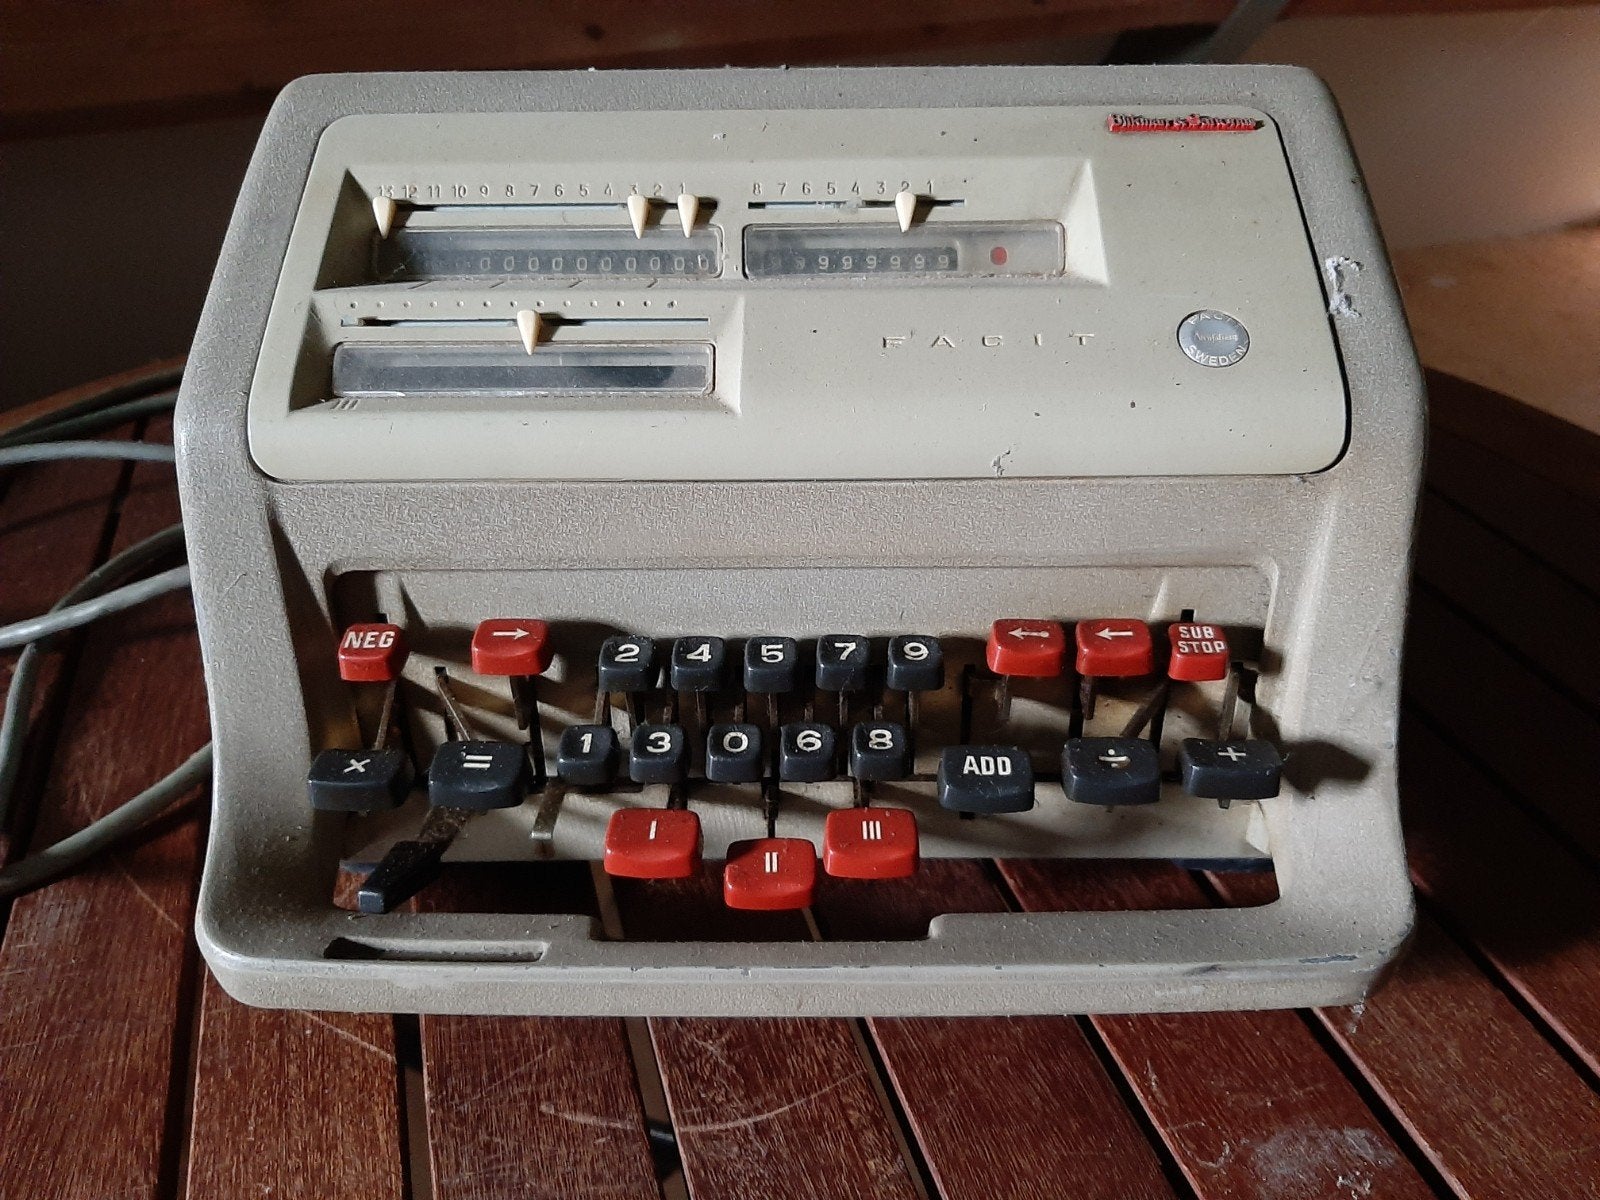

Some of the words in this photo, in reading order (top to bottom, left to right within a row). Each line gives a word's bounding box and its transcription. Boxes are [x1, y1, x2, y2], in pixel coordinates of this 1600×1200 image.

[402, 185, 418, 199] 12
[428, 185, 442, 198] 11
[452, 185, 468, 198] 10
[479, 185, 490, 198] 9
[505, 184, 516, 198] 8
[529, 184, 541, 197] 7
[554, 184, 564, 197] 6
[579, 184, 590, 197] 5
[604, 183, 614, 196] 4
[653, 183, 663, 196] 2
[752, 181, 762, 195] 8
[777, 181, 787, 195] 7
[802, 181, 812, 195] 6
[826, 181, 837, 195] 5
[851, 181, 861, 195] 4
[876, 180, 887, 194] 3
[926, 180, 934, 194] 1
[882, 333, 1096, 349] FACIT
[1184, 344, 1247, 366] SWEDEN
[344, 630, 396, 649] NEG
[1178, 625, 1214, 639] SUB
[614, 643, 641, 662] 2
[686, 643, 712, 662] 4
[760, 644, 784, 663] 5
[833, 642, 857, 660] 7
[903, 642, 929, 660] 9
[1177, 640, 1225, 654] STOP
[579, 732, 593, 754] 1
[645, 731, 672, 754] 3
[722, 731, 749, 753] 0
[796, 729, 822, 752] 6
[868, 729, 894, 750] 8
[962, 755, 1012, 776] ADD
